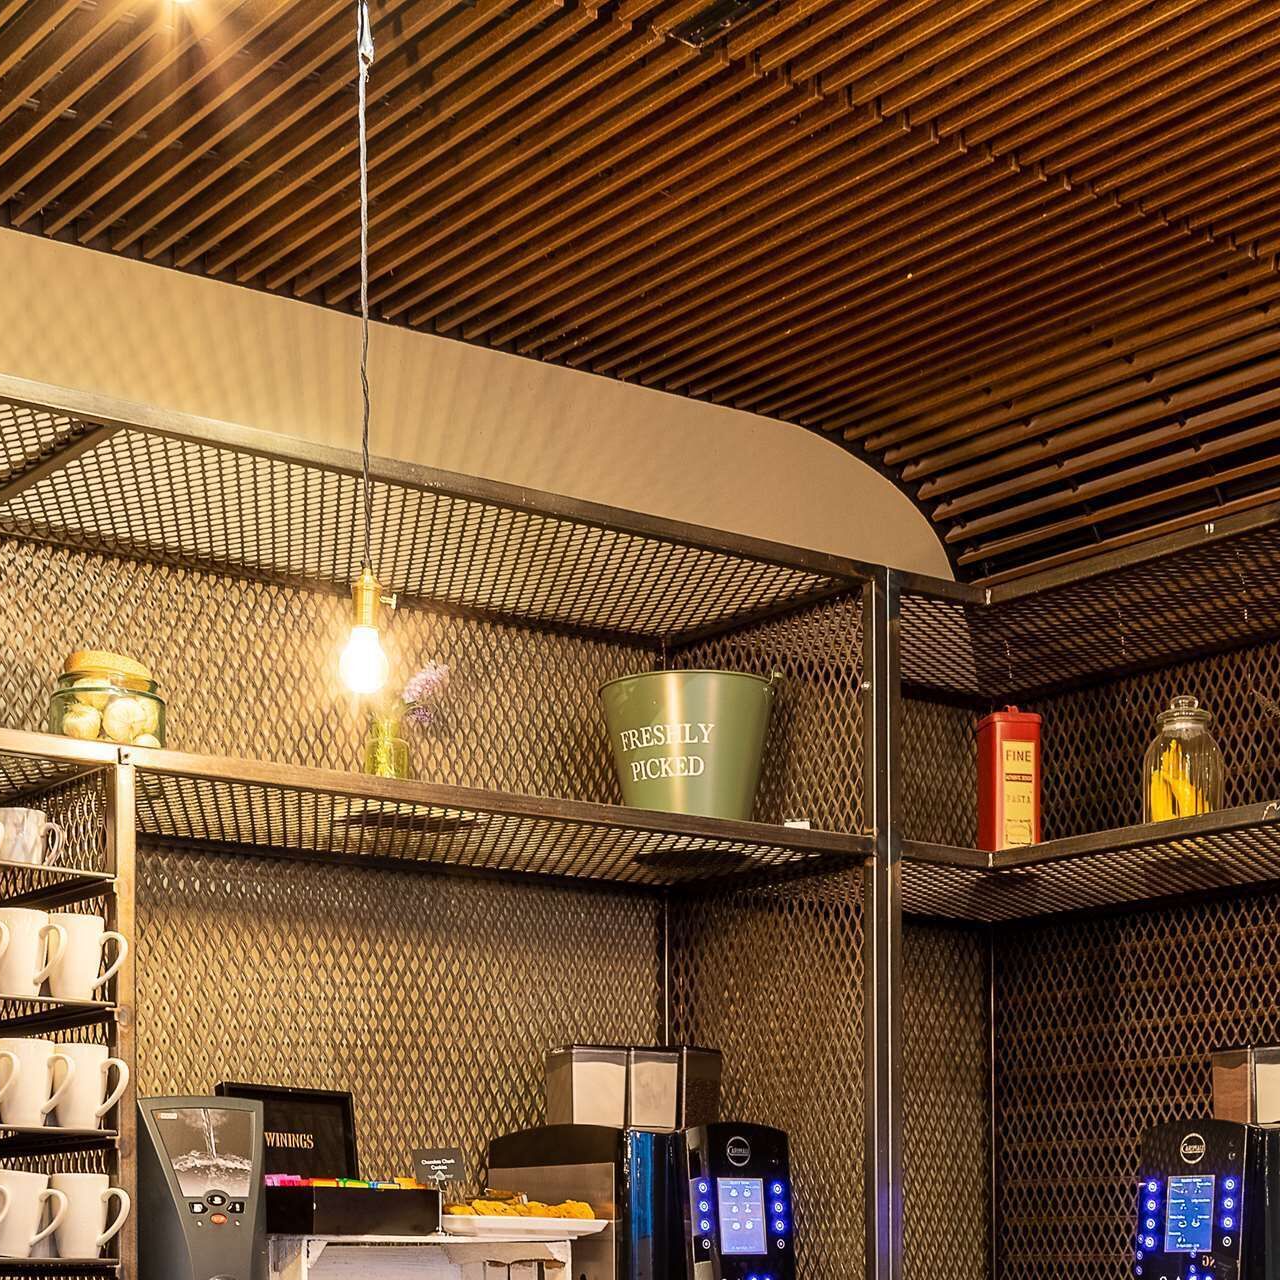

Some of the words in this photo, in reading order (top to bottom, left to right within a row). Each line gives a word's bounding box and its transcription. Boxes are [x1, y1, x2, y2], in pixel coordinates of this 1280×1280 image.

[619, 722, 716, 753] FRESHLY
[1005, 750, 1032, 762] FINE
[630, 755, 706, 783] PICKED
[263, 1131, 315, 1150] WININGS
